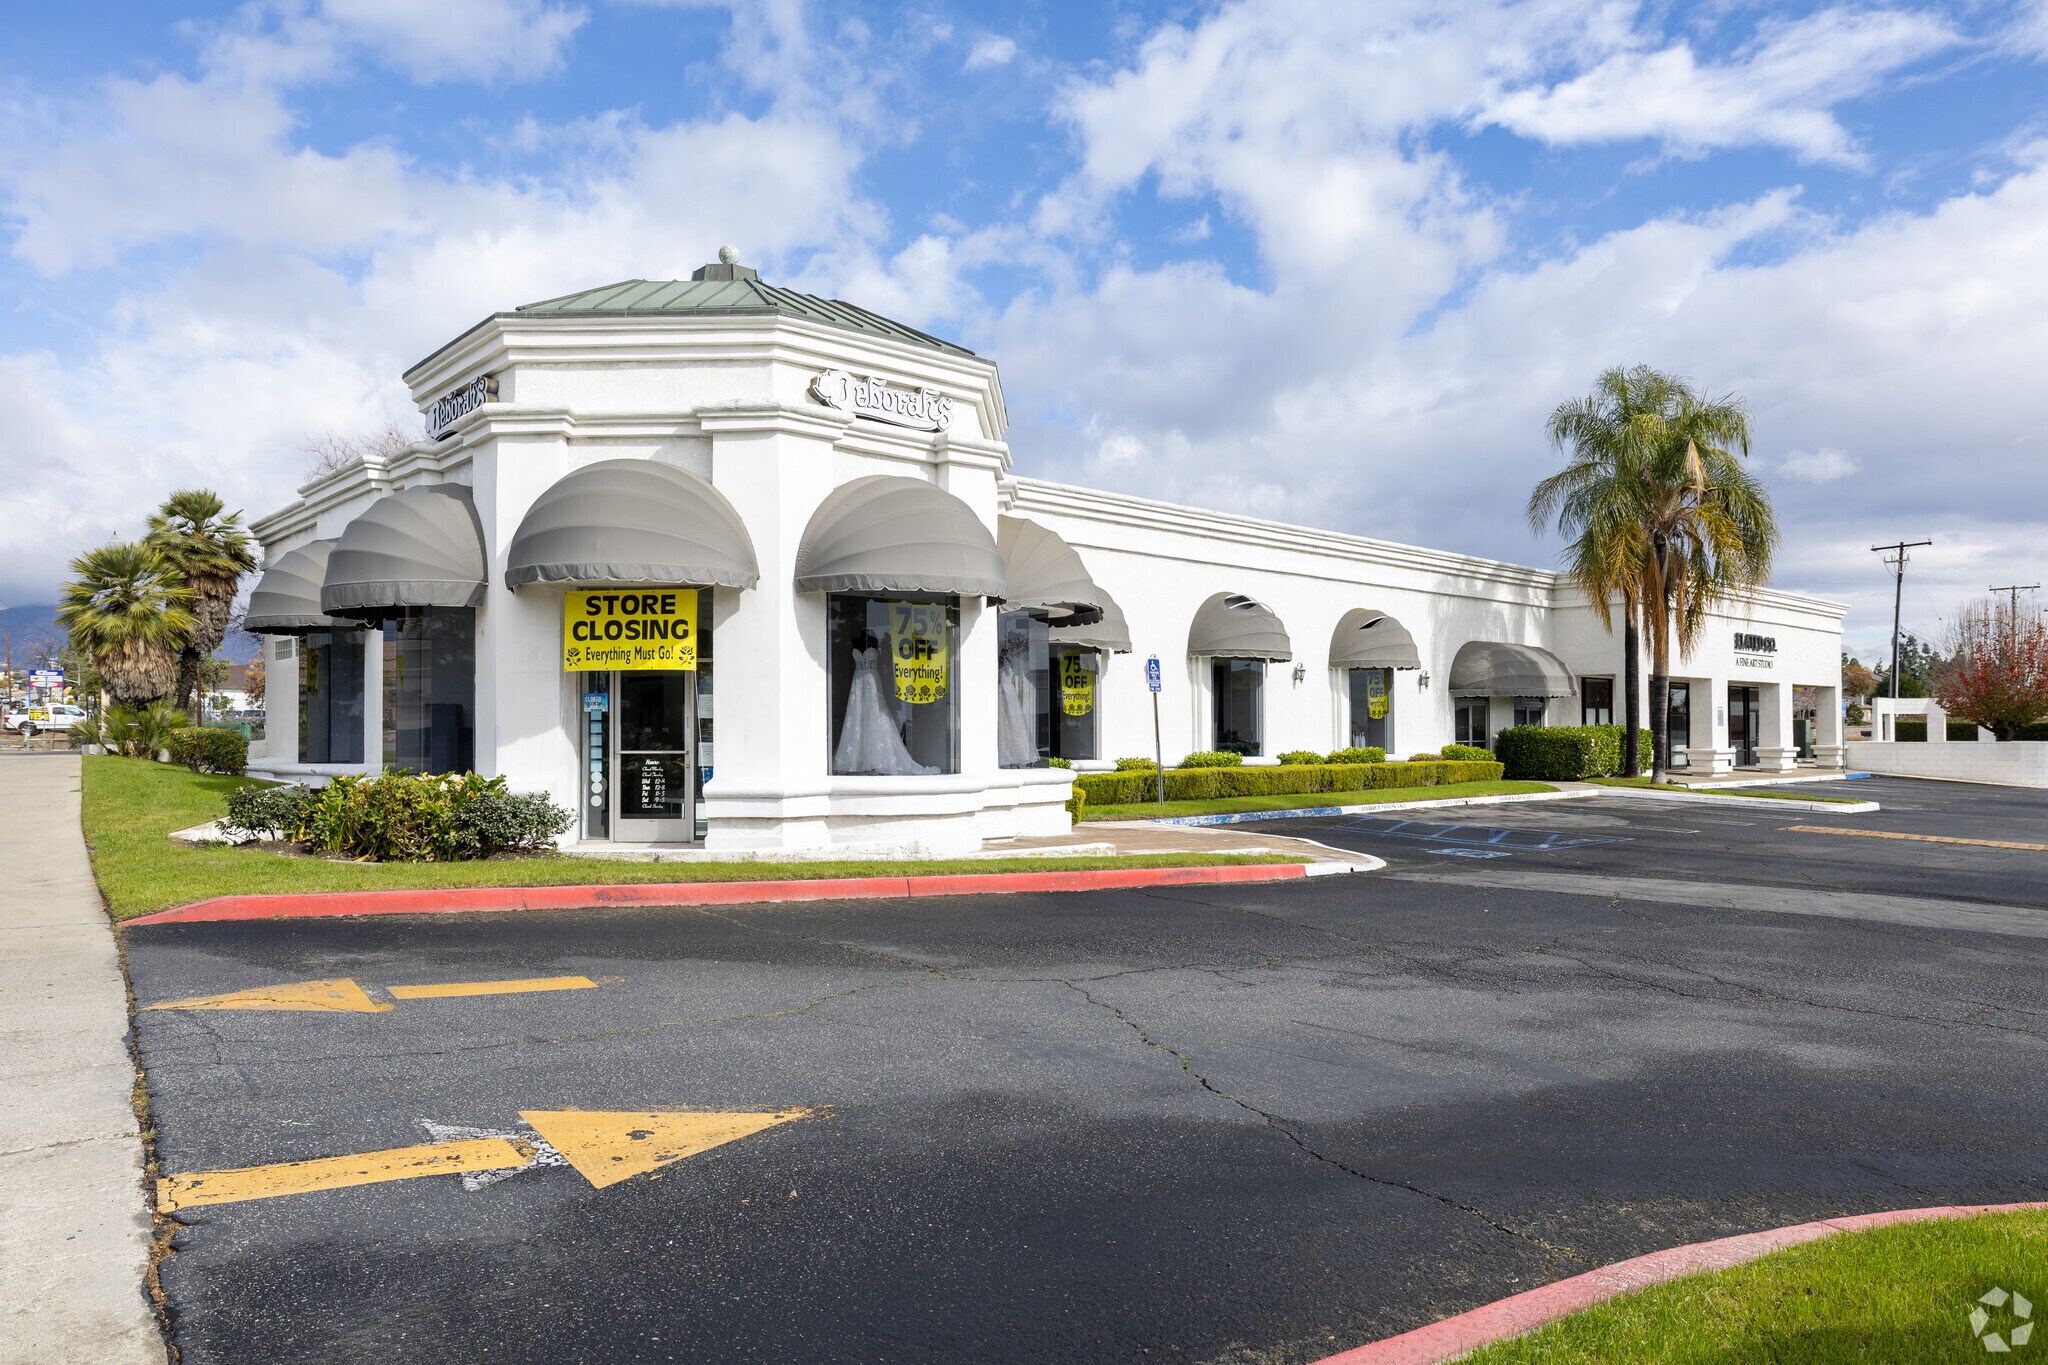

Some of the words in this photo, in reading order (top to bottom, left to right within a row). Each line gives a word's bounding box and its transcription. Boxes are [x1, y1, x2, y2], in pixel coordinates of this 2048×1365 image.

[585, 595, 676, 616] STORE
[572, 619, 689, 641] CLOSING
[896, 606, 942, 636] 75%
[585, 646, 631, 665] Everything
[634, 646, 655, 660] Must
[658, 645, 674, 660] Go!
[898, 638, 938, 660] OFF
[894, 663, 943, 683] Everything!
[1740, 657, 1750, 667] FINE
[1750, 658, 1758, 668] ART
[1758, 659, 1774, 669] STUDIO
[1065, 675, 1088, 689] OFF
[1369, 687, 1384, 698] OFF
